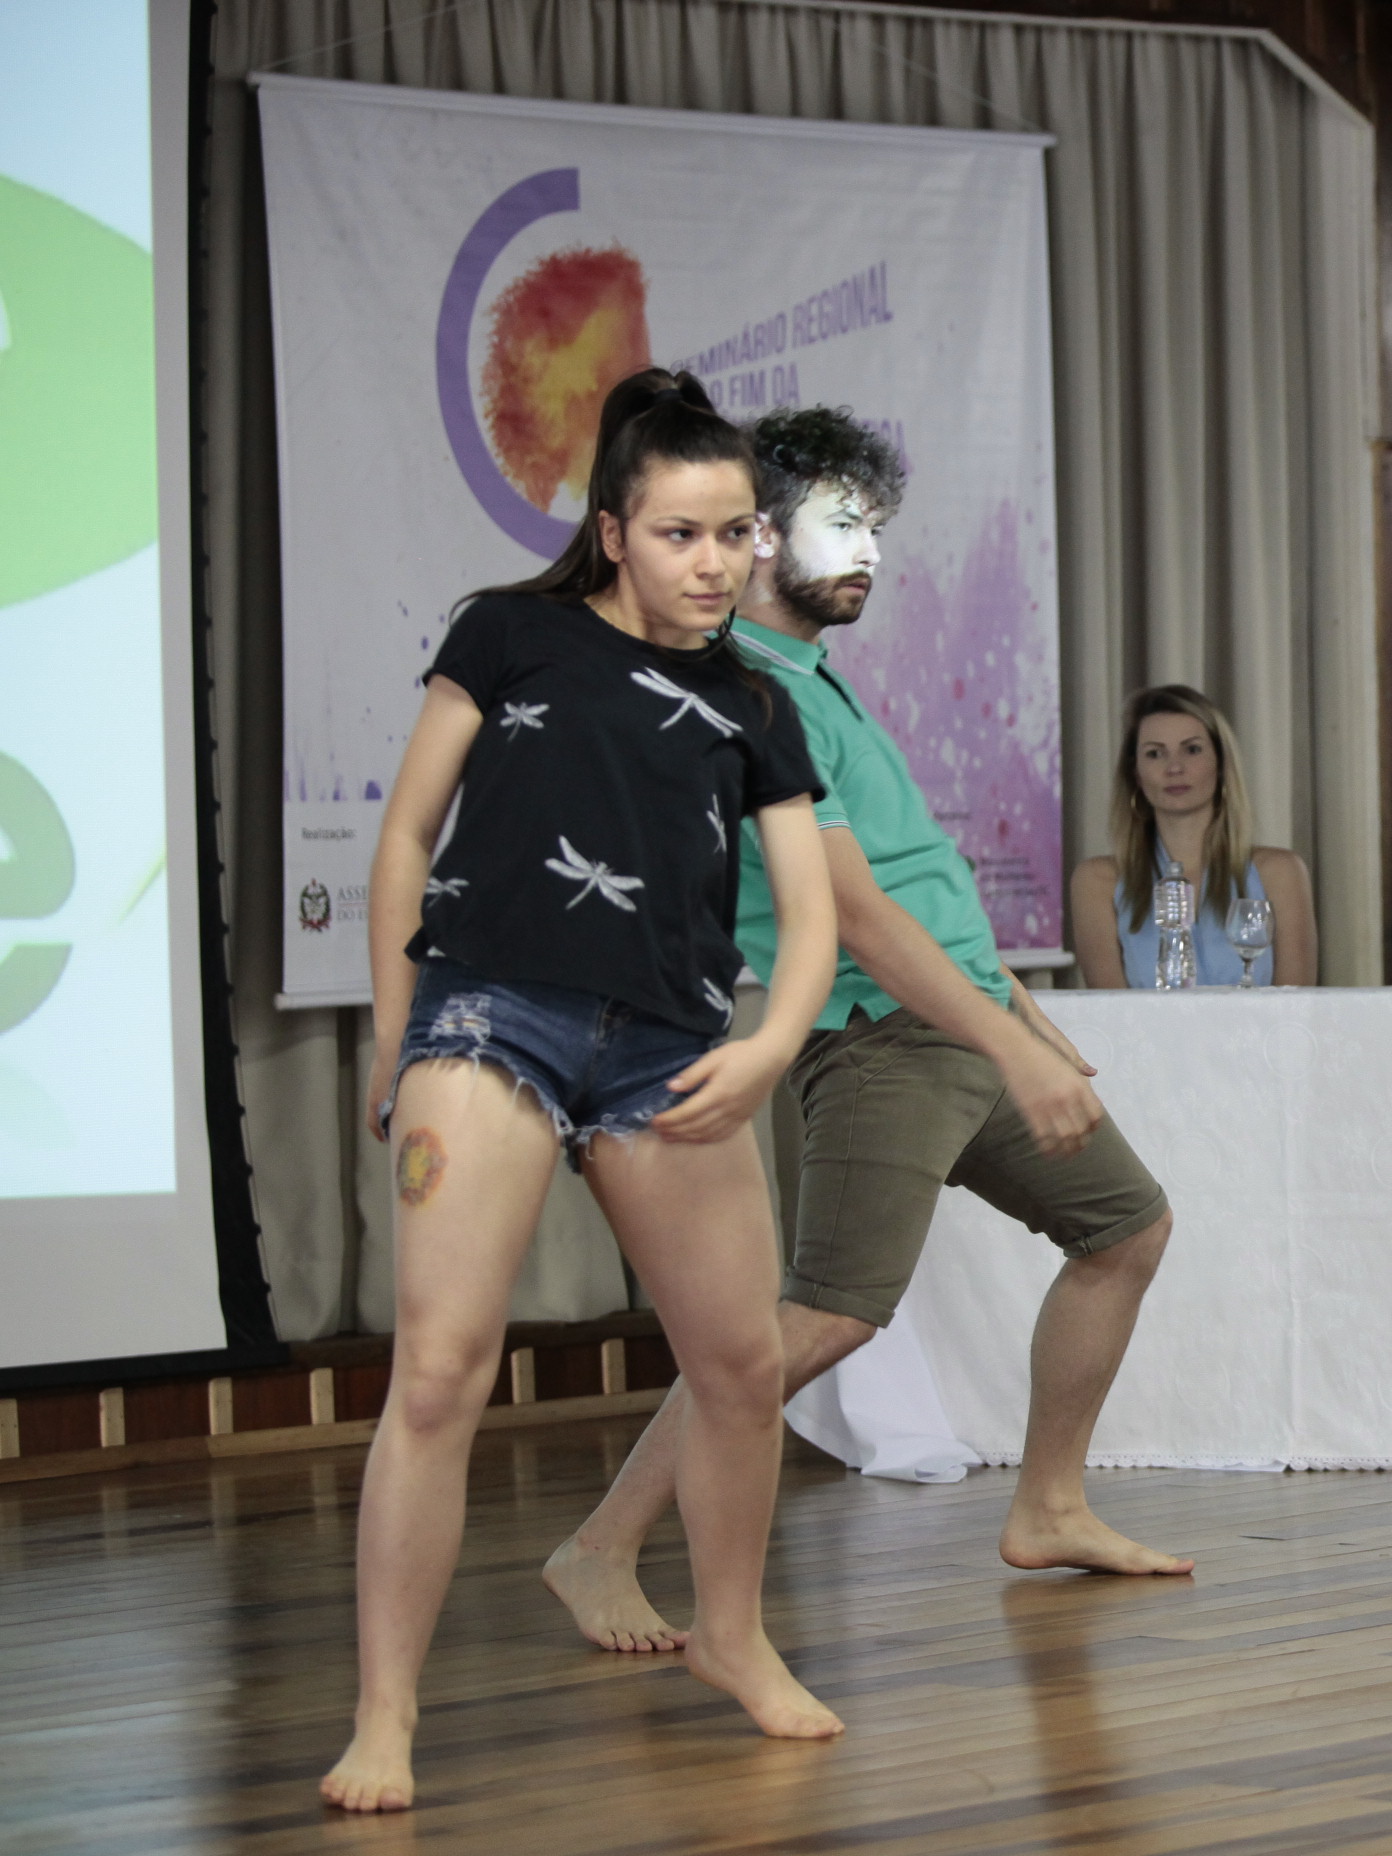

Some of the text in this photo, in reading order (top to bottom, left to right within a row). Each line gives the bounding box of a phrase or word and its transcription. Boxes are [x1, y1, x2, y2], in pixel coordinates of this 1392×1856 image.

[792, 260, 893, 347] REGIONAL
[729, 369, 767, 407] FIM
[772, 362, 799, 406] DA
